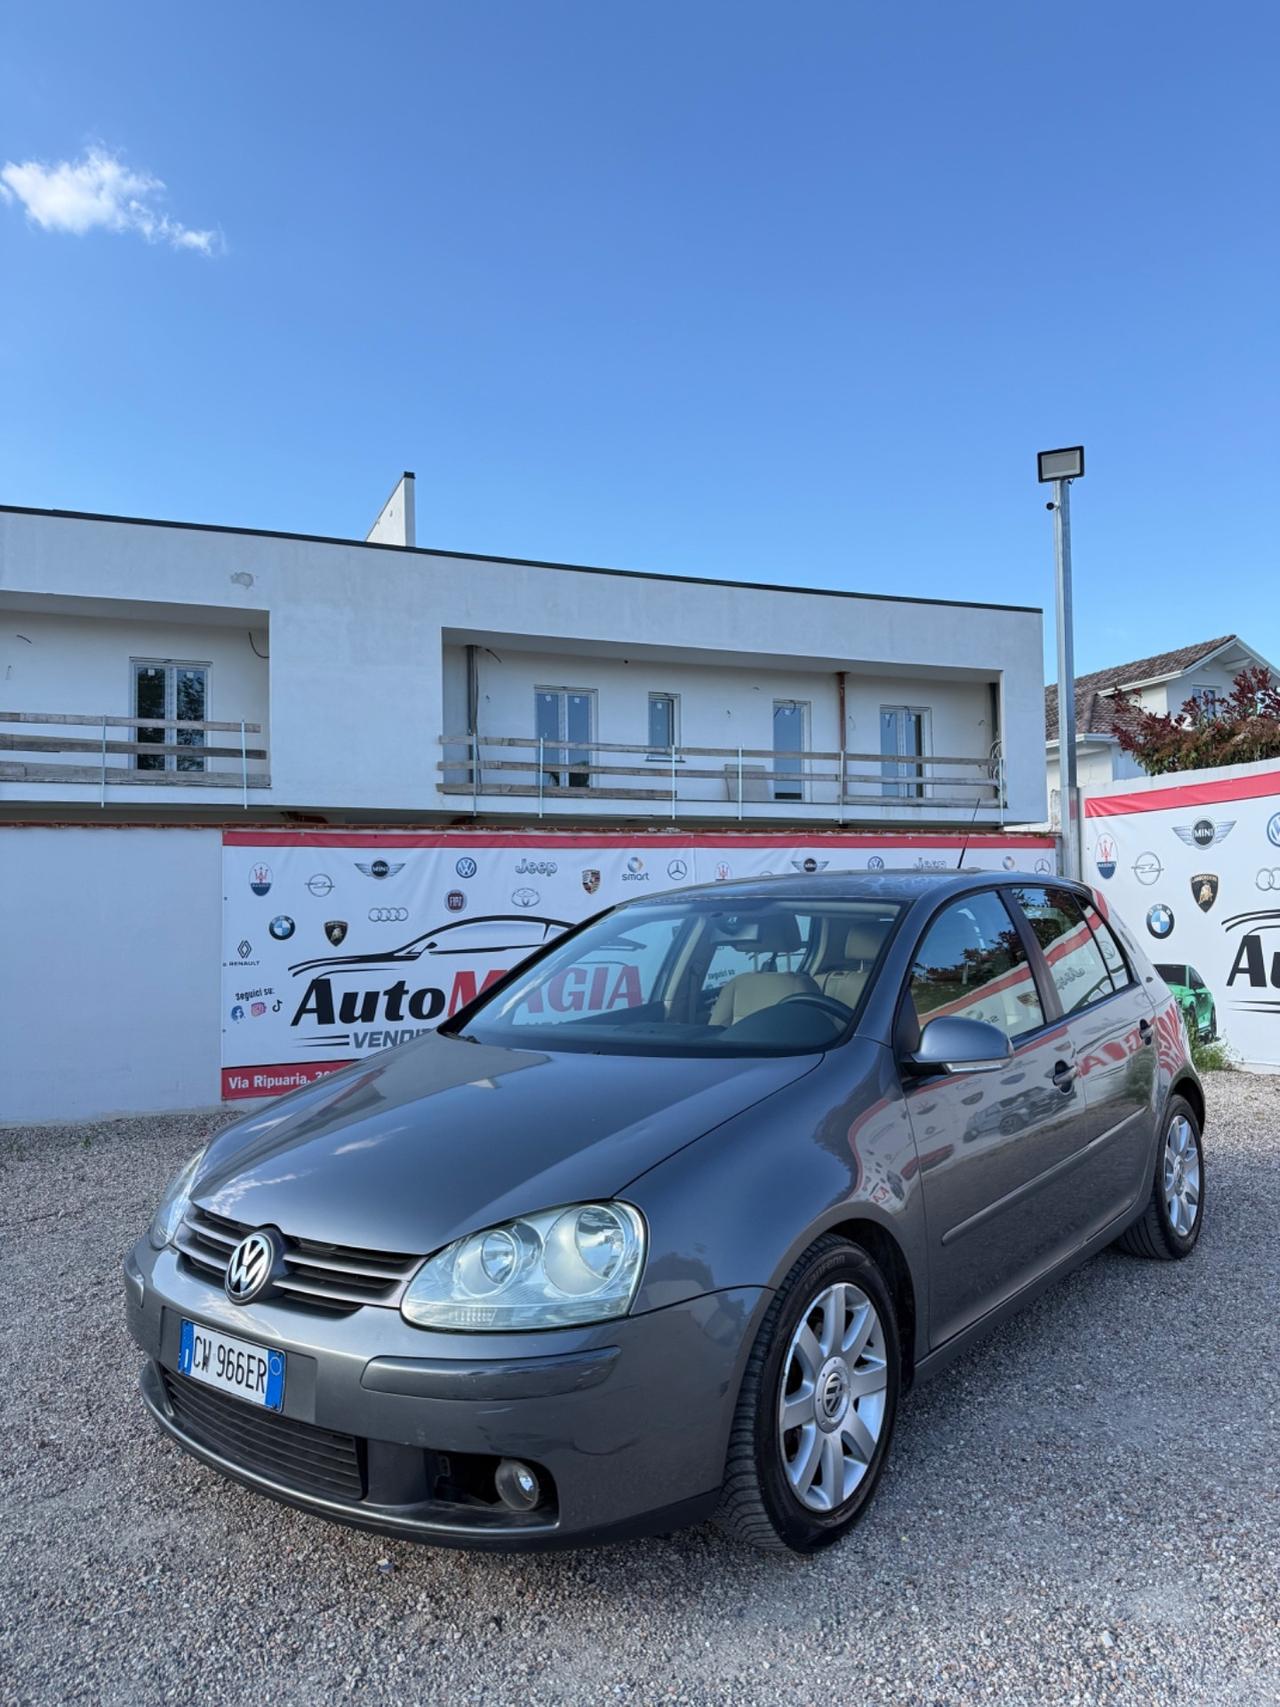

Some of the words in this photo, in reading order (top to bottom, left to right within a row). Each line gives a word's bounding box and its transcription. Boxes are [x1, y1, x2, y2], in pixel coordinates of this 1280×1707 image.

[1194, 828, 1214, 837] MINI
[515, 859, 558, 876] Jeep
[622, 872, 649, 881] smart
[228, 1076, 249, 1089] Via
[193, 1336, 211, 1373] CW
[216, 1344, 267, 1394] 966ER
